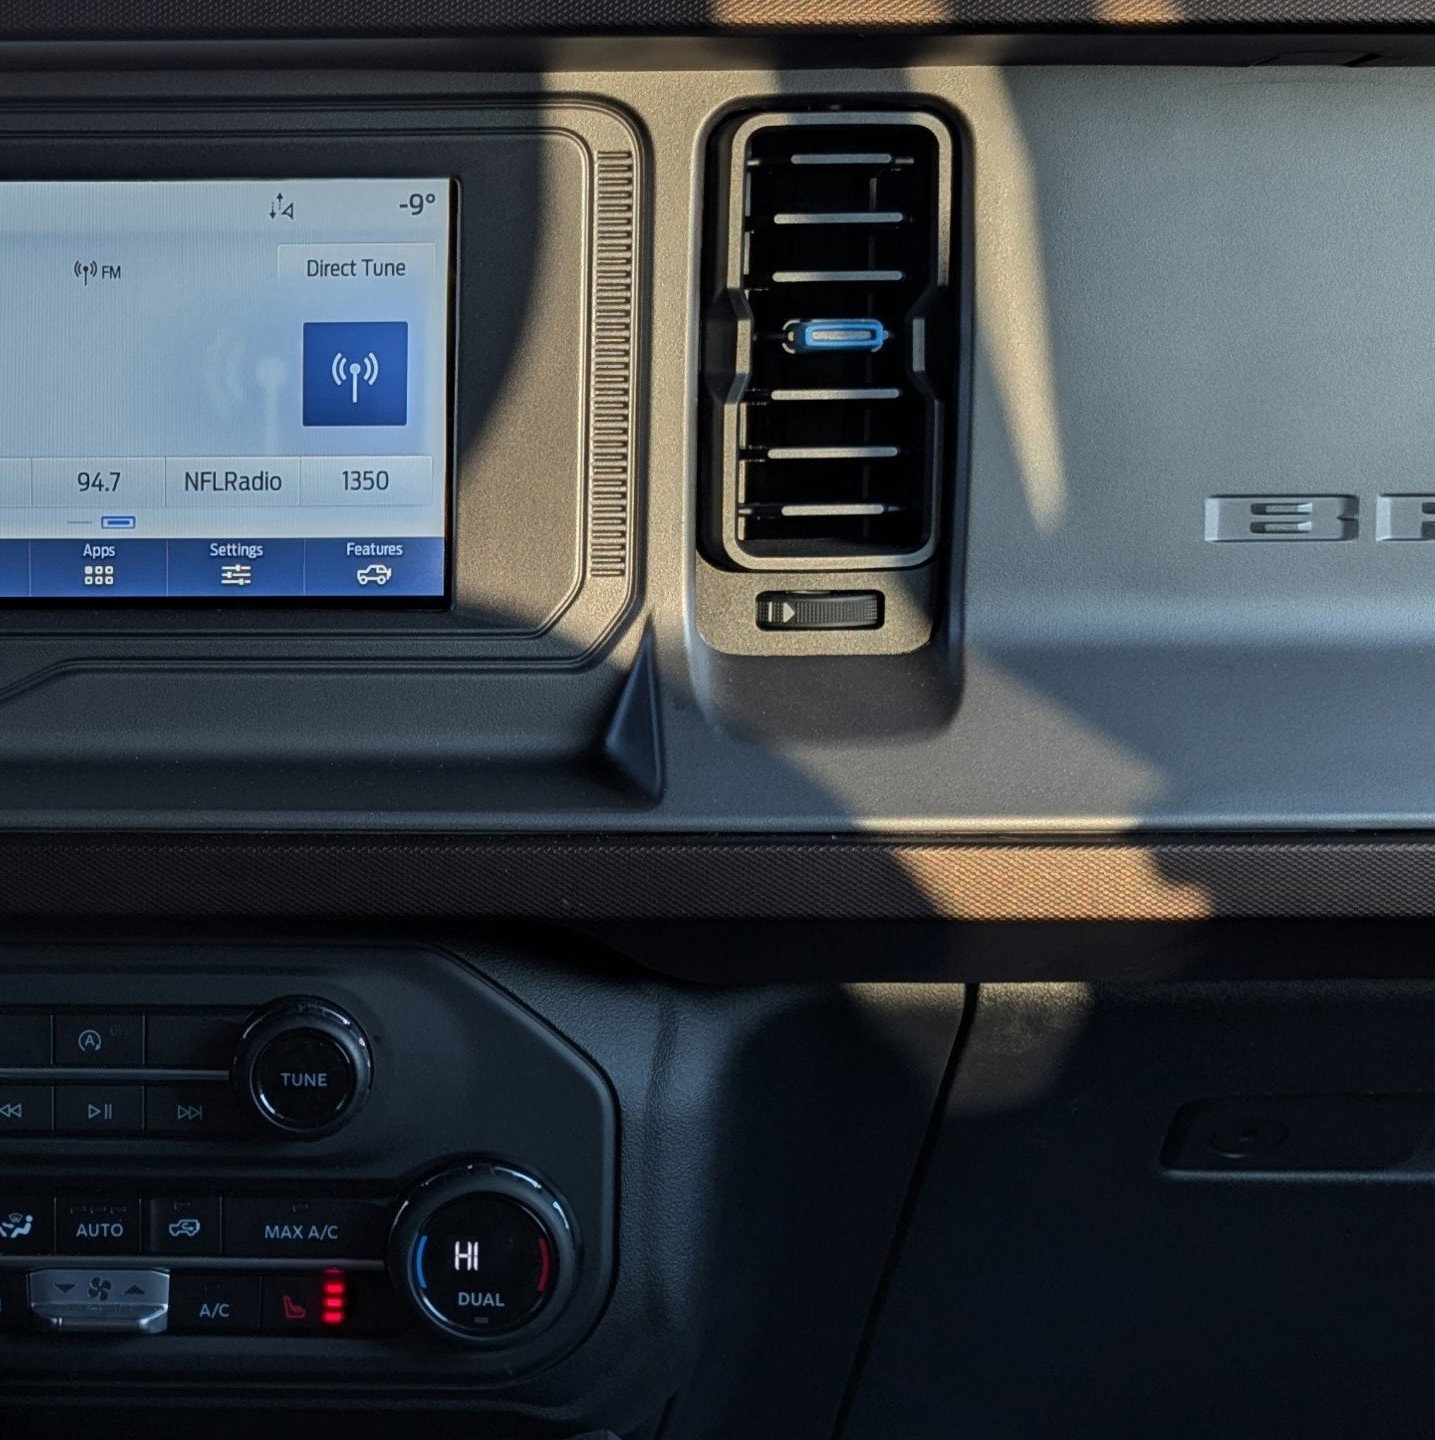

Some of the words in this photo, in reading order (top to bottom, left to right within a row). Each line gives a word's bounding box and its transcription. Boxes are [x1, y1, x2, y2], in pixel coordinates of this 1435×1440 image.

[399, 193, 436, 216] -9°
[101, 265, 121, 279] FM
[306, 258, 357, 277] Direct
[361, 258, 407, 277] Tune
[77, 471, 122, 492] 94.7
[184, 470, 282, 492] NFLRadio
[342, 469, 389, 491] 1350
[82, 543, 116, 560] Apps
[209, 543, 264, 560] Settings
[346, 542, 403, 556] Features
[280, 1073, 328, 1087] TUNE
[76, 1224, 124, 1238] AUTO
[264, 1225, 303, 1239] MAX
[308, 1224, 338, 1240] A/C
[454, 1241, 479, 1271] HI
[458, 1292, 505, 1307] DUAL
[199, 1303, 230, 1318] A/C
